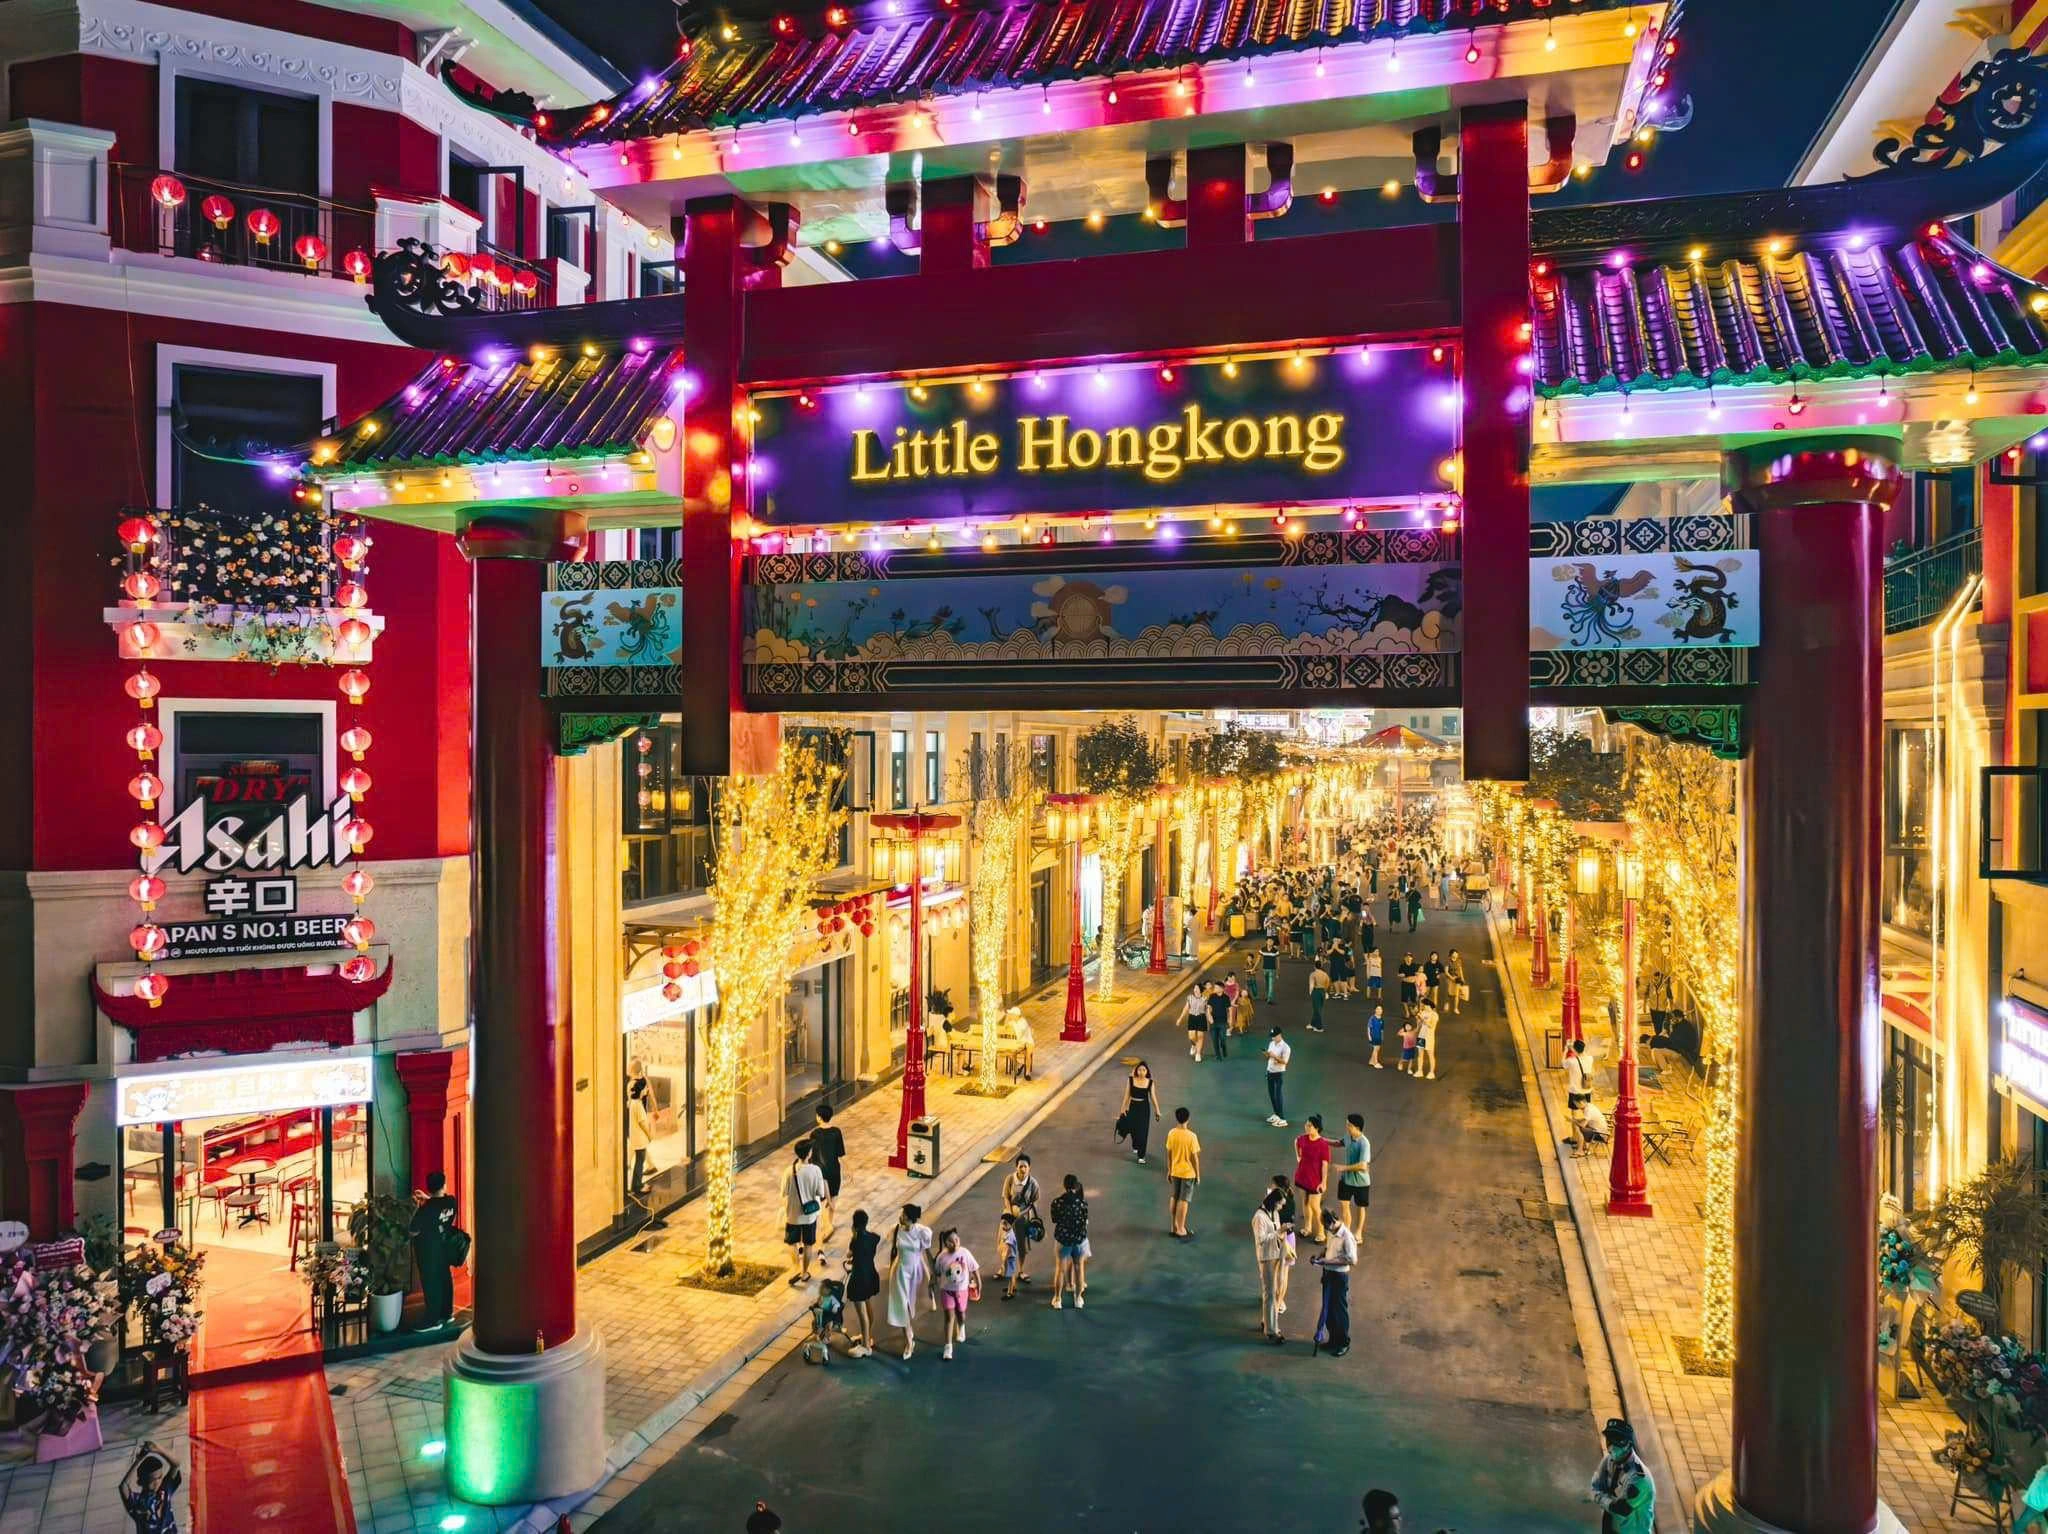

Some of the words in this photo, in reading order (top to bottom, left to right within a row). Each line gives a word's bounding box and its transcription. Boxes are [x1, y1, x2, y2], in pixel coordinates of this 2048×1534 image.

[851, 419, 998, 480] Little
[1017, 404, 1345, 480] Hongkong
[139, 792, 351, 875] Asahi
[207, 878, 295, 915] 辛口
[243, 921, 288, 939] NO.1
[294, 918, 348, 936] BEER
